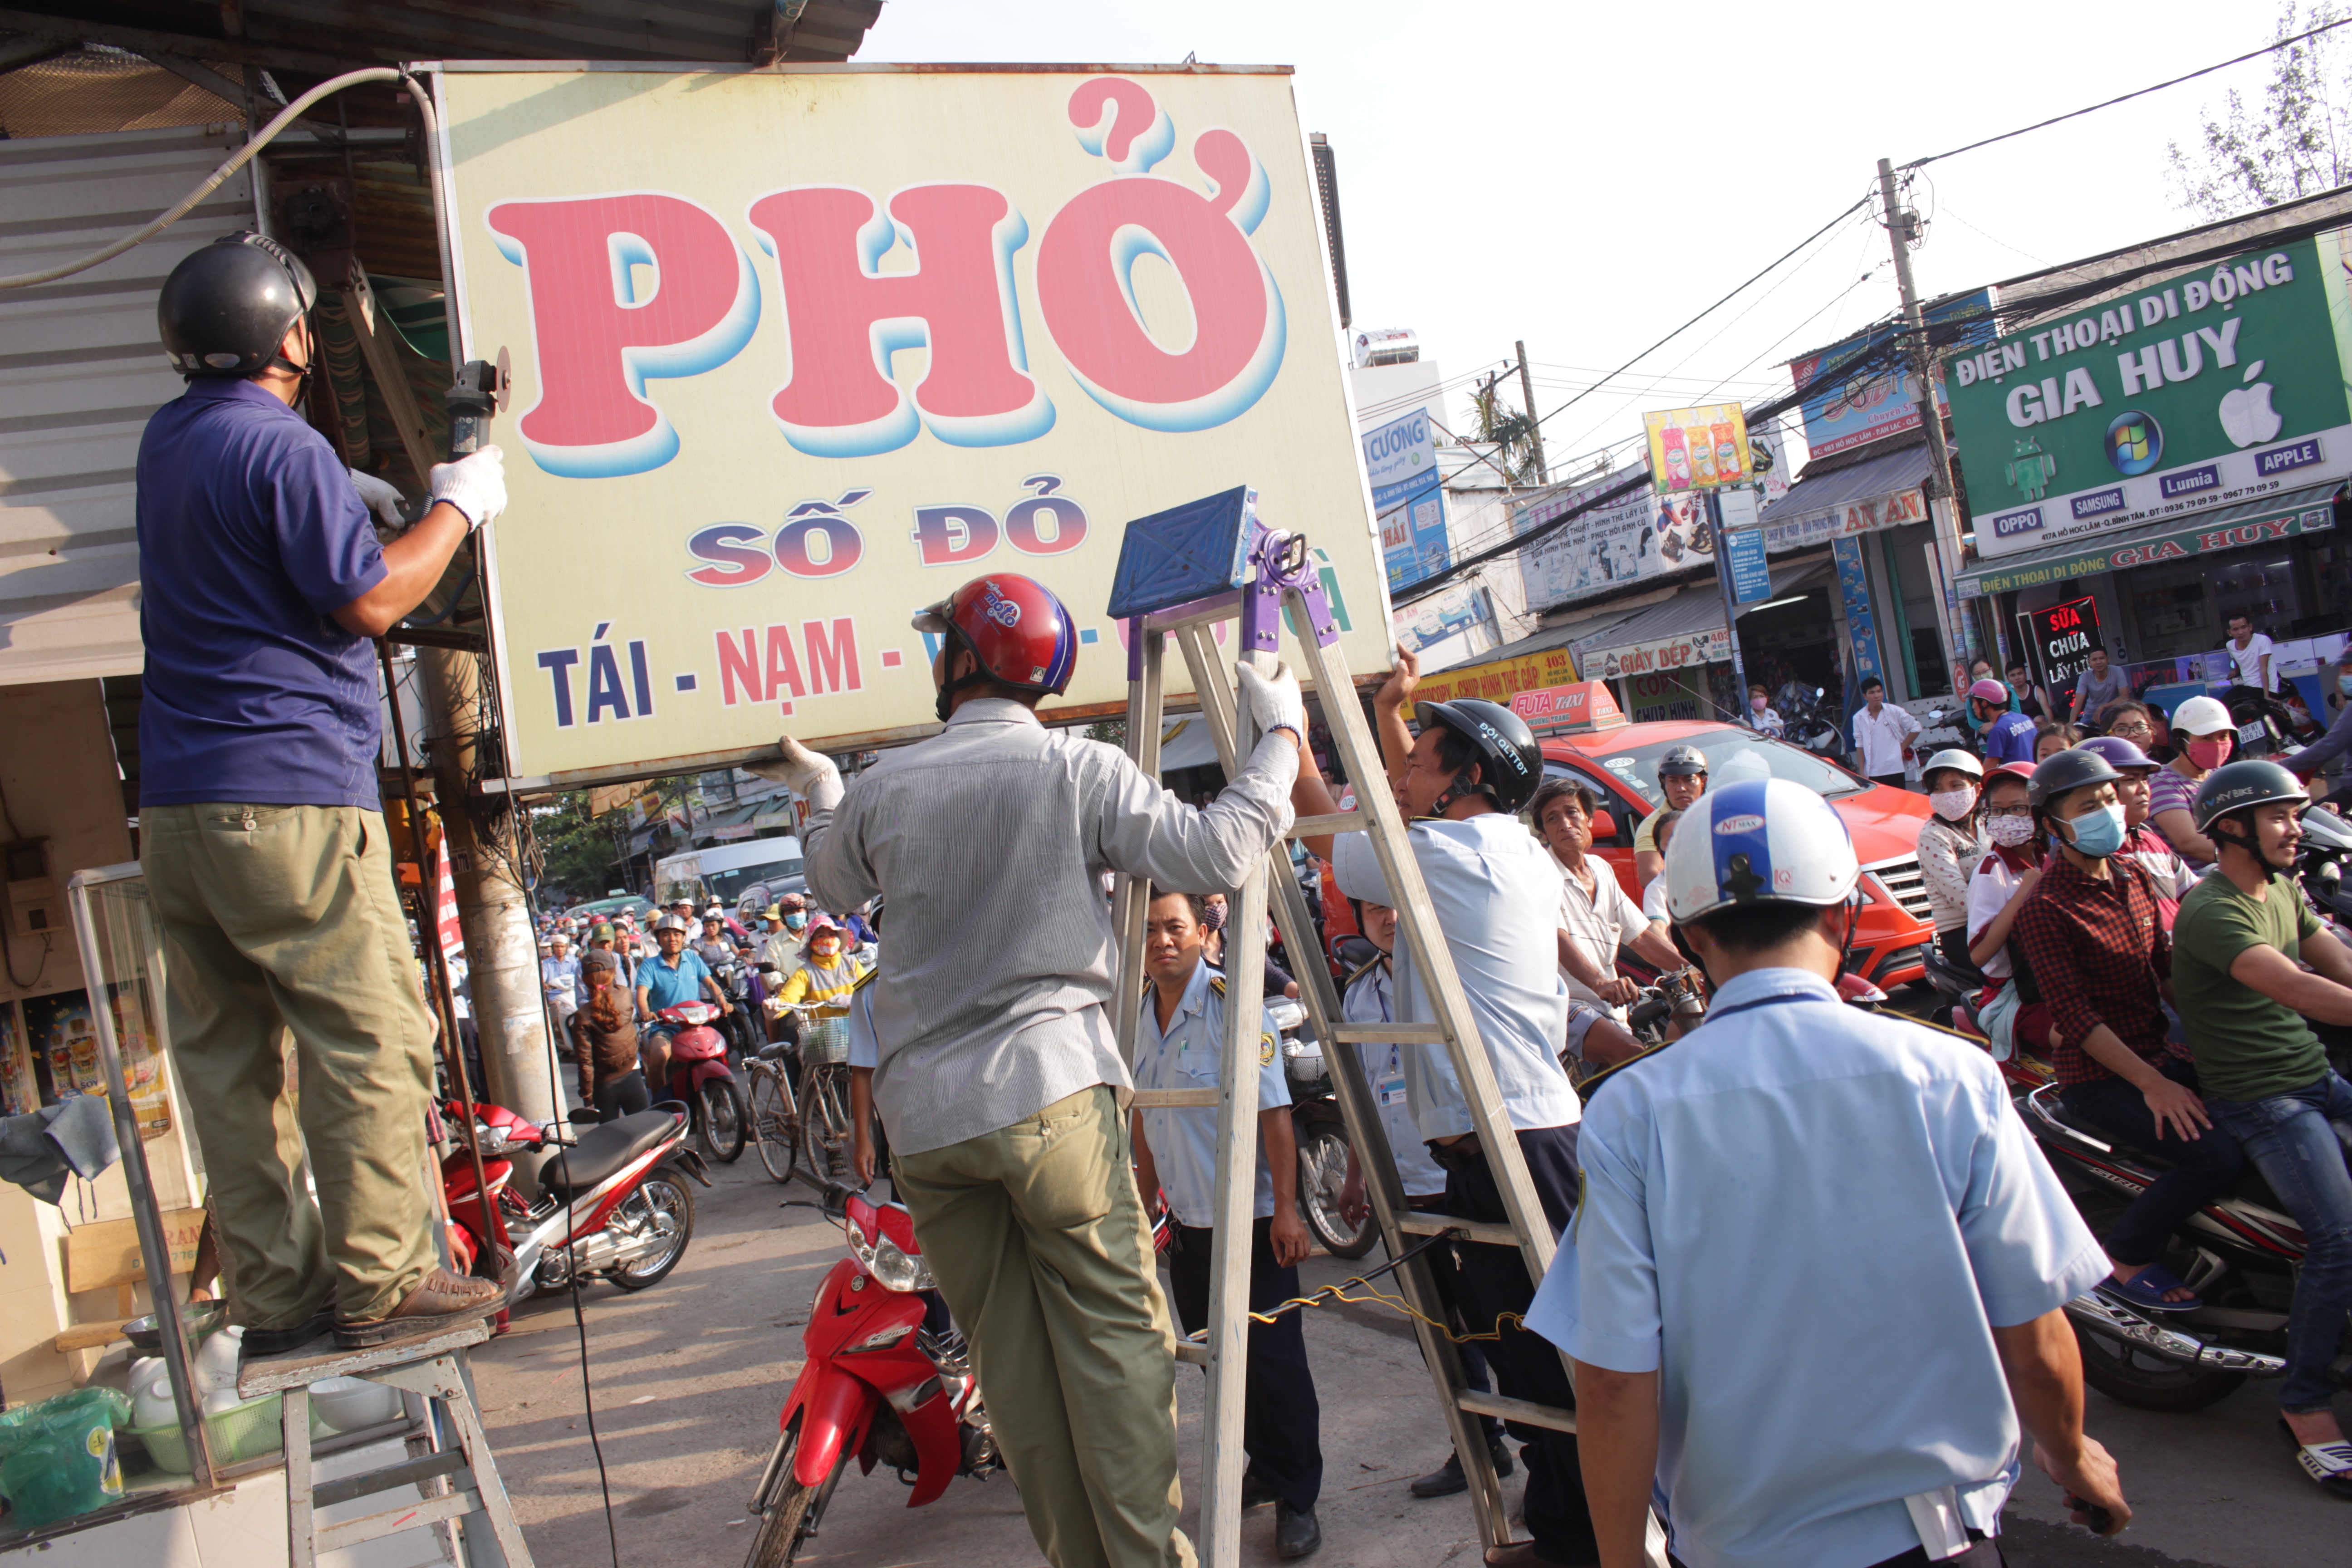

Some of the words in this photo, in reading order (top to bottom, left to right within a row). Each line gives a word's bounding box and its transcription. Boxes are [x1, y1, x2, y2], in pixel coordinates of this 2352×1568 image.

[485, 75, 1288, 479] PHỞ
[1955, 340, 2027, 387] ĐIỆN
[2029, 304, 2136, 362] THOẠI
[2139, 288, 2180, 327] DI
[2183, 252, 2294, 313] ĐỘNG
[2006, 366, 2103, 428] GIA
[2117, 316, 2243, 397] HUY
[1370, 418, 1426, 461] CƯƠNG
[1823, 442, 1834, 452] 403
[1835, 437, 1845, 448] HỒ
[1845, 435, 1859, 446] HỌC
[1890, 422, 1901, 431] LẠC
[2264, 445, 2313, 471] APPLE
[2166, 471, 2214, 494] Lumia
[1529, 490, 1588, 527] THÁI
[1844, 501, 1879, 534] AN
[1885, 492, 1921, 524] AN
[2041, 531, 2057, 541] 417A
[2058, 526, 2068, 536] HỒ
[2130, 510, 2146, 521] TÂN
[2164, 503, 2184, 514] 0936
[2185, 500, 2196, 509] 79
[2196, 497, 2207, 506] 09
[2208, 495, 2218, 504] 59
[2223, 489, 2243, 500] 0967
[2245, 486, 2255, 495] 79
[2256, 483, 2267, 492] 09
[2269, 480, 2280, 490] 59
[2075, 492, 2120, 514] SAMSUNG
[684, 488, 876, 590] SỐ
[909, 472, 1091, 568] ĐỎ
[1383, 517, 1407, 548] HẢI
[1595, 517, 1610, 528] HÌNH
[1999, 512, 2037, 533] OPPO
[1544, 541, 1559, 555] HÌNH
[2109, 540, 2189, 568] GIA
[2195, 516, 2297, 553] HUY
[1982, 576, 2011, 593] ĐIỆN
[2013, 568, 2050, 584] THOẠI
[2053, 566, 2067, 578] DI
[2070, 558, 2106, 576] ĐỘNG
[984, 592, 1016, 628] moto
[1544, 654, 1567, 669] 403
[1620, 647, 1655, 674] GIÀY
[1658, 639, 1693, 668] DÉP
[535, 621, 658, 732] TÁI
[712, 616, 864, 720] NẠM
[1410, 683, 1452, 703] PHOTOCOPY
[1481, 670, 1503, 697] HÌNH
[1501, 661, 1521, 694] THẺ
[1521, 657, 1540, 690] GẤP
[1636, 671, 1681, 697] COPY
[1515, 691, 1553, 716] FUTA
[1555, 692, 1585, 710] TAXI
[1592, 694, 1612, 708] FUTA
[1596, 706, 1613, 715] TAXI
[1668, 697, 1698, 720] HÌNH
[1479, 722, 1499, 740] ĐỘI
[1551, 713, 1570, 724] TRANG
[1607, 758, 1632, 767] 009
[2215, 791, 2232, 804] MY
[2232, 787, 2255, 798] BIKE
[1737, 820, 1757, 829] MAX
[80, 1079, 98, 1089] SOY
